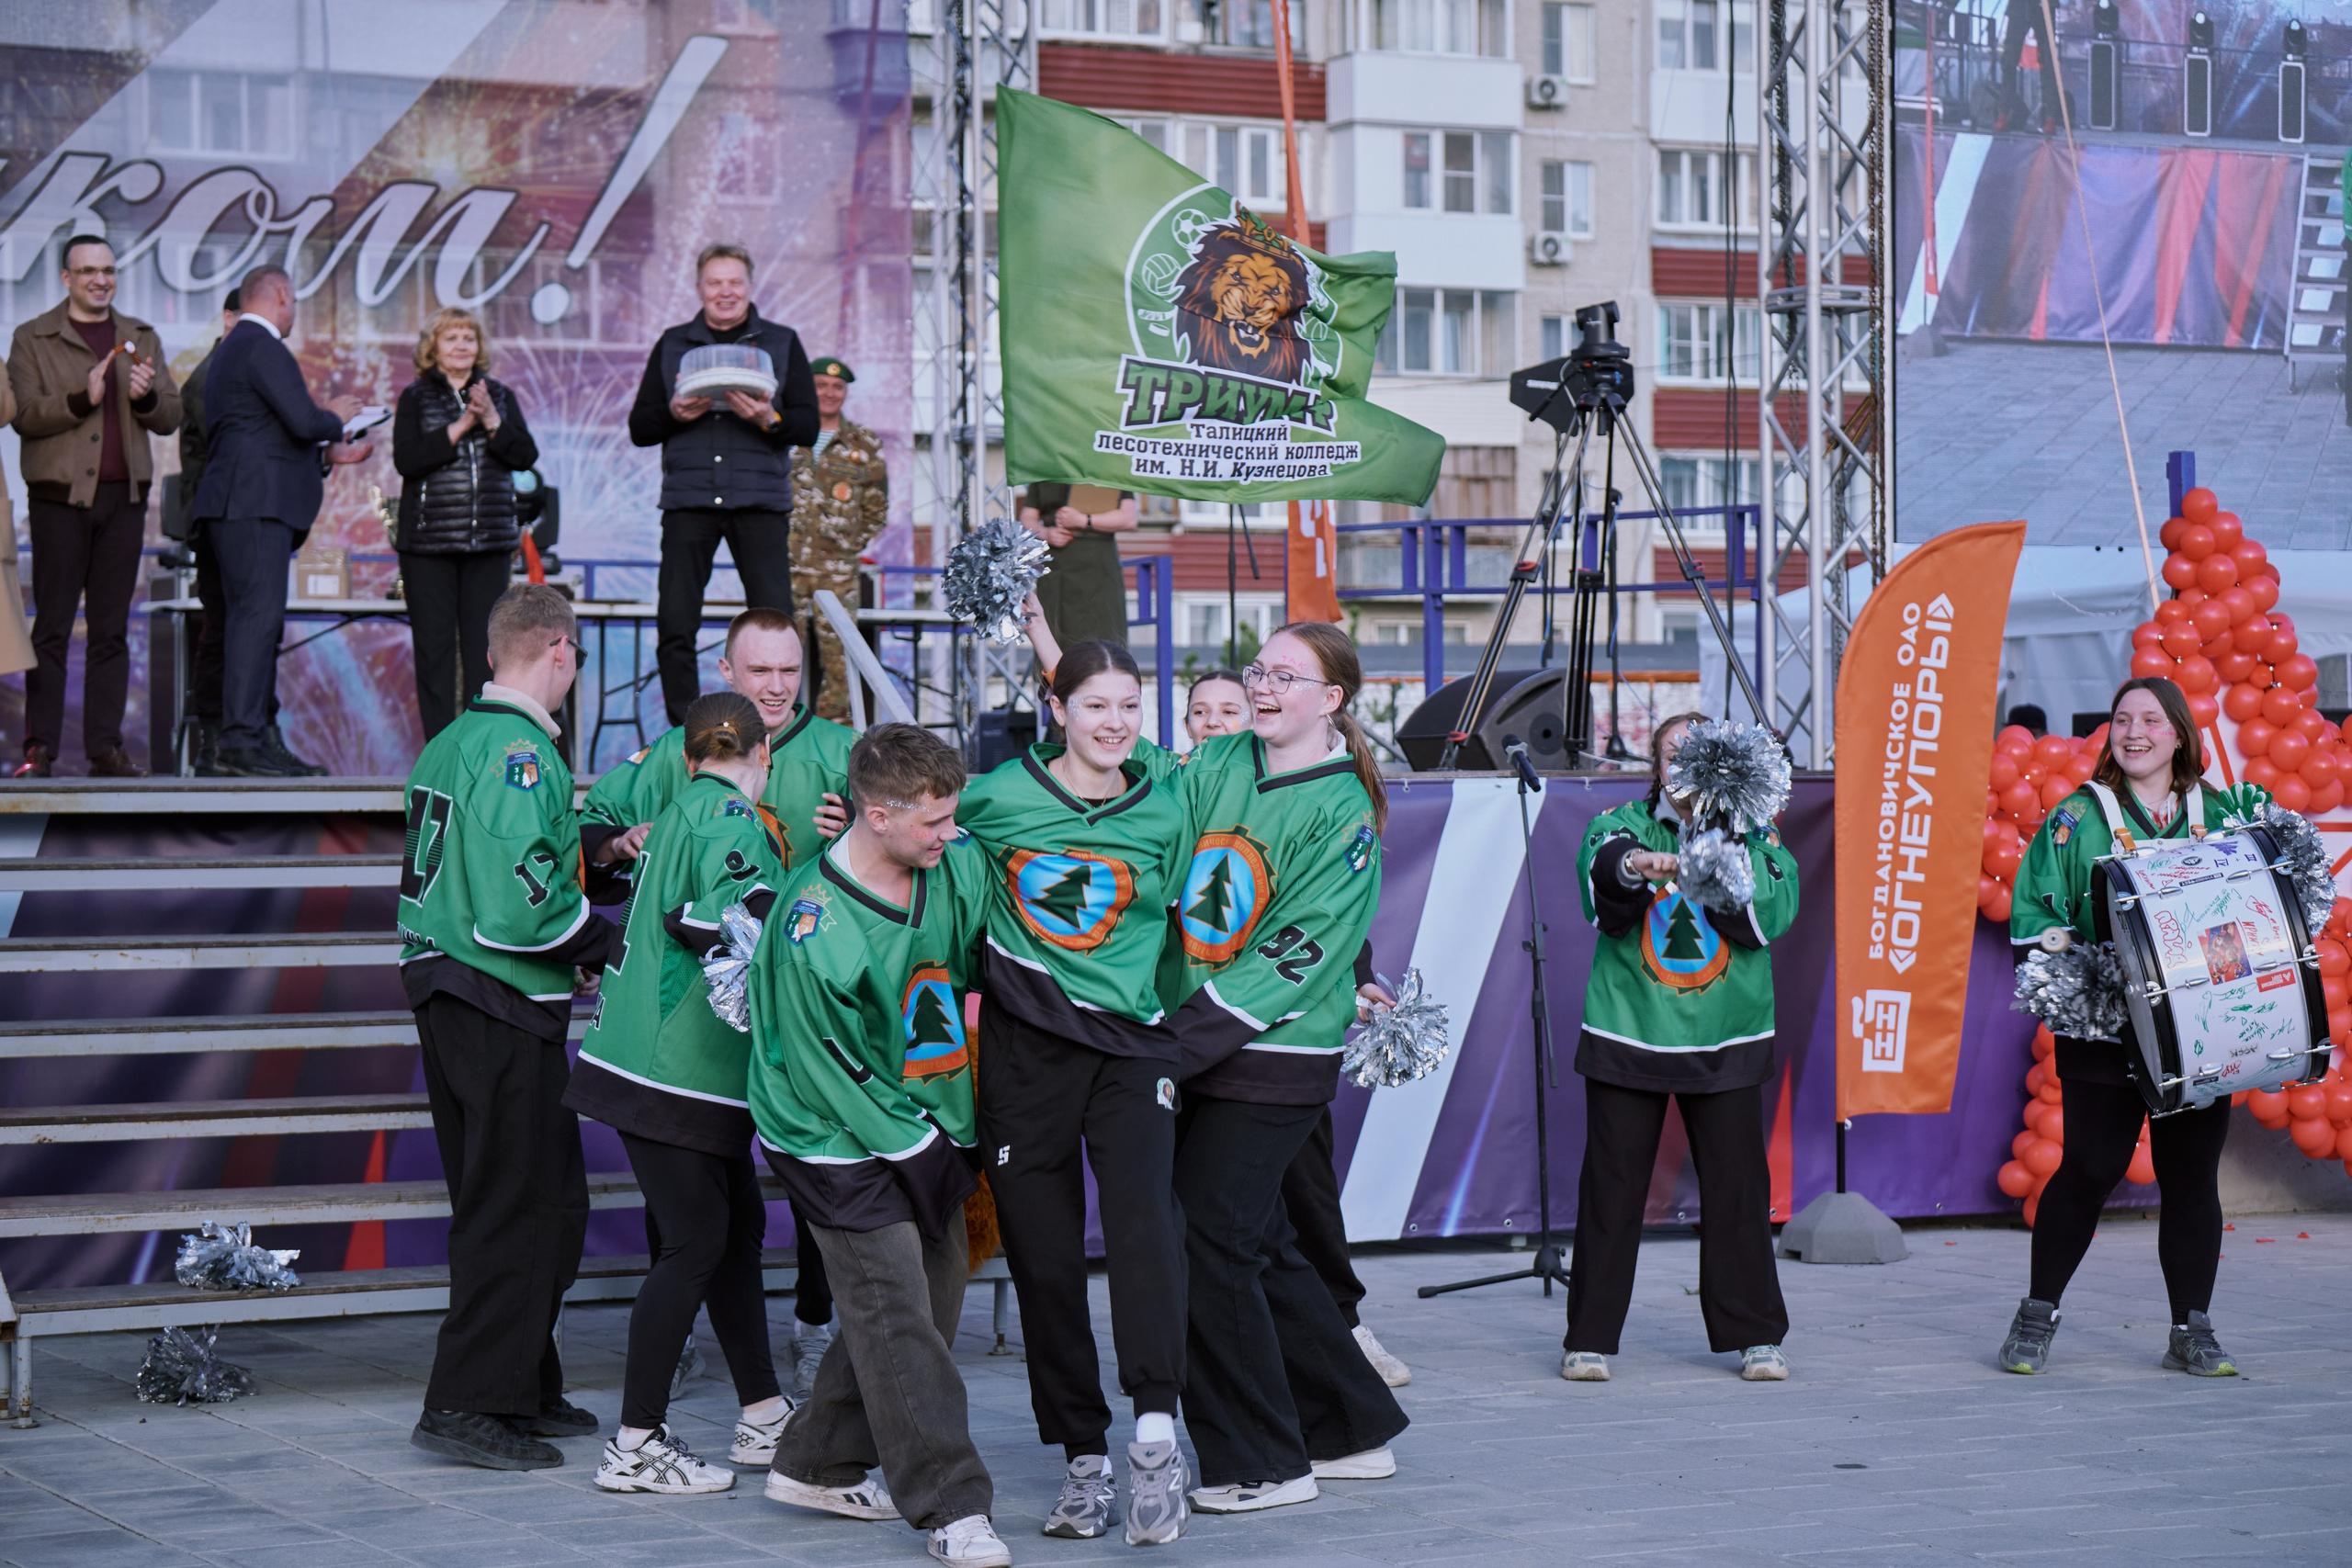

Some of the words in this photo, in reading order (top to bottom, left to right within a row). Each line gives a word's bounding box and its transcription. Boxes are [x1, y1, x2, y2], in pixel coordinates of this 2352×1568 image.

[1191, 423, 1288, 441] Талицкий
[1098, 433, 1279, 459] лесотехнический
[1284, 444, 1358, 460] колледж
[1136, 459, 1170, 476] им.
[1181, 460, 1223, 478] Н.И.
[1230, 462, 1329, 481] Кузнецова
[1869, 682, 1911, 960] БОГДАНОВИЧСКОЕ
[1896, 602, 1921, 667] ОАО
[1256, 924, 1326, 987] 92
